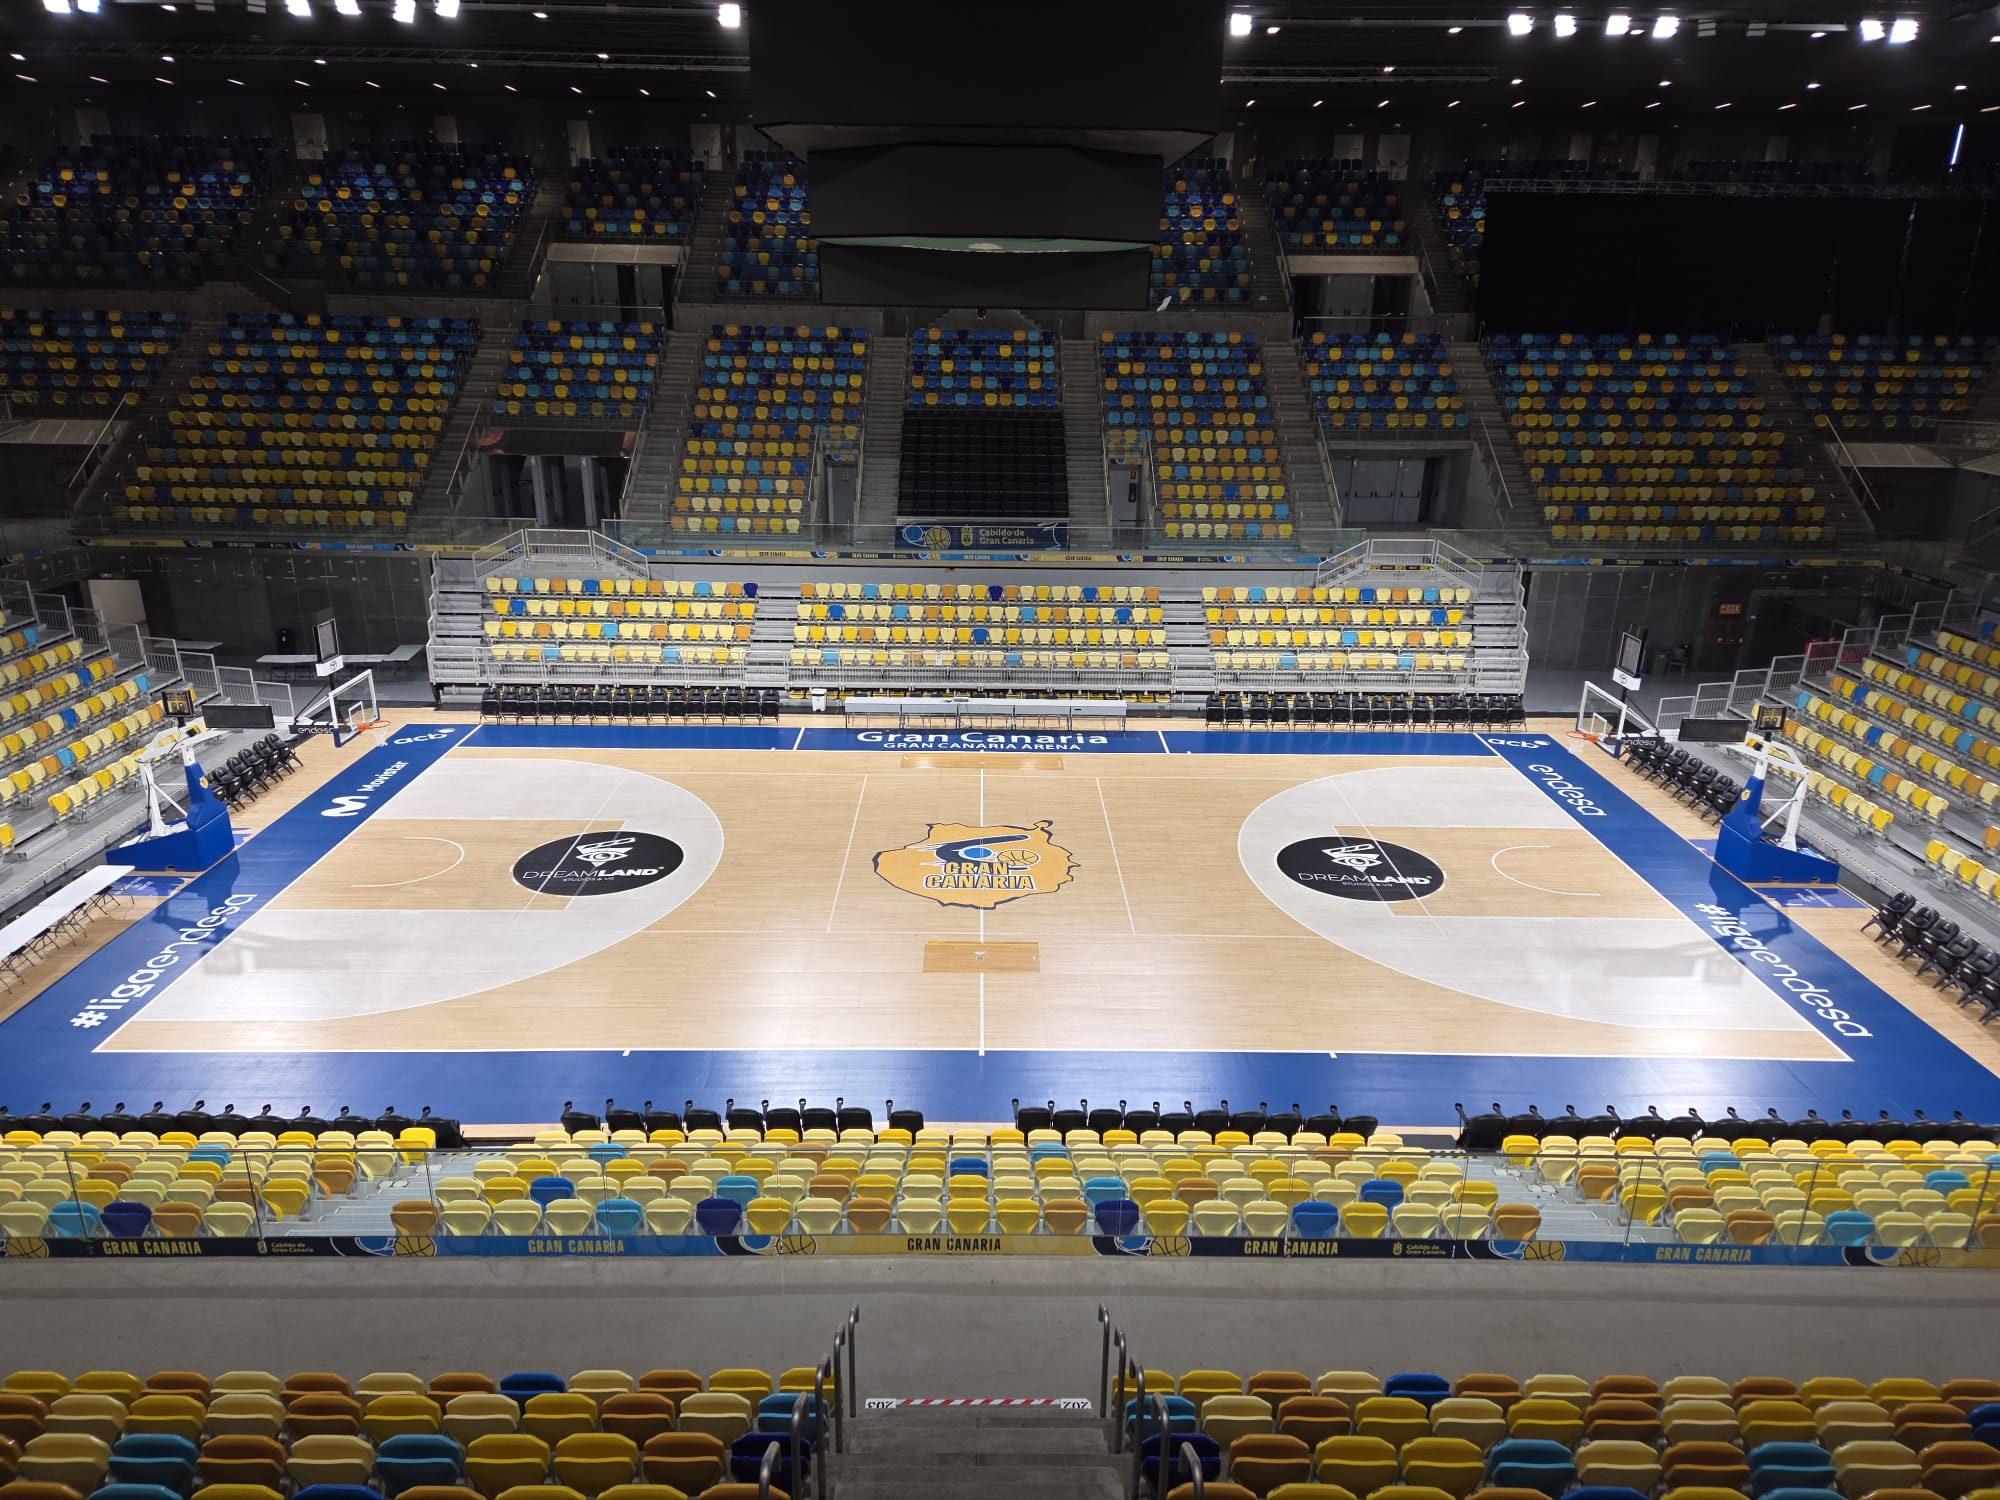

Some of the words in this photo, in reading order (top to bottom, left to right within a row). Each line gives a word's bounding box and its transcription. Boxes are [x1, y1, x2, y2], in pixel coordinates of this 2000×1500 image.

[980, 529, 1012, 537] Cabildo
[1014, 529, 1024, 537] de
[980, 537, 1000, 545] Gran
[1002, 537, 1034, 545] Canaria
[393, 731, 448, 745] acb
[856, 731, 949, 743] Gran
[959, 732, 1108, 744] Canaria
[1487, 738, 1541, 749] acb
[357, 761, 408, 791] Movistar
[1528, 764, 1608, 817] endesa
[944, 861, 1010, 875] GRAN
[925, 874, 1035, 889] CANARIA
[70, 893, 257, 1028] #ligaendesa
[1693, 902, 1874, 1039] #ligaendesa
[102, 1241, 139, 1255] GRAN
[143, 1241, 202, 1255] CANARIA
[528, 1240, 563, 1253] GRAN
[568, 1240, 624, 1253] CANARIA
[907, 1238, 940, 1251] GRAN
[947, 1238, 1001, 1251] CANARIA
[1244, 1241, 1278, 1254] GRAN
[1284, 1241, 1338, 1255] CANARIA
[1655, 1247, 1691, 1260] GRAN
[1695, 1248, 1751, 1261] CANARIA
